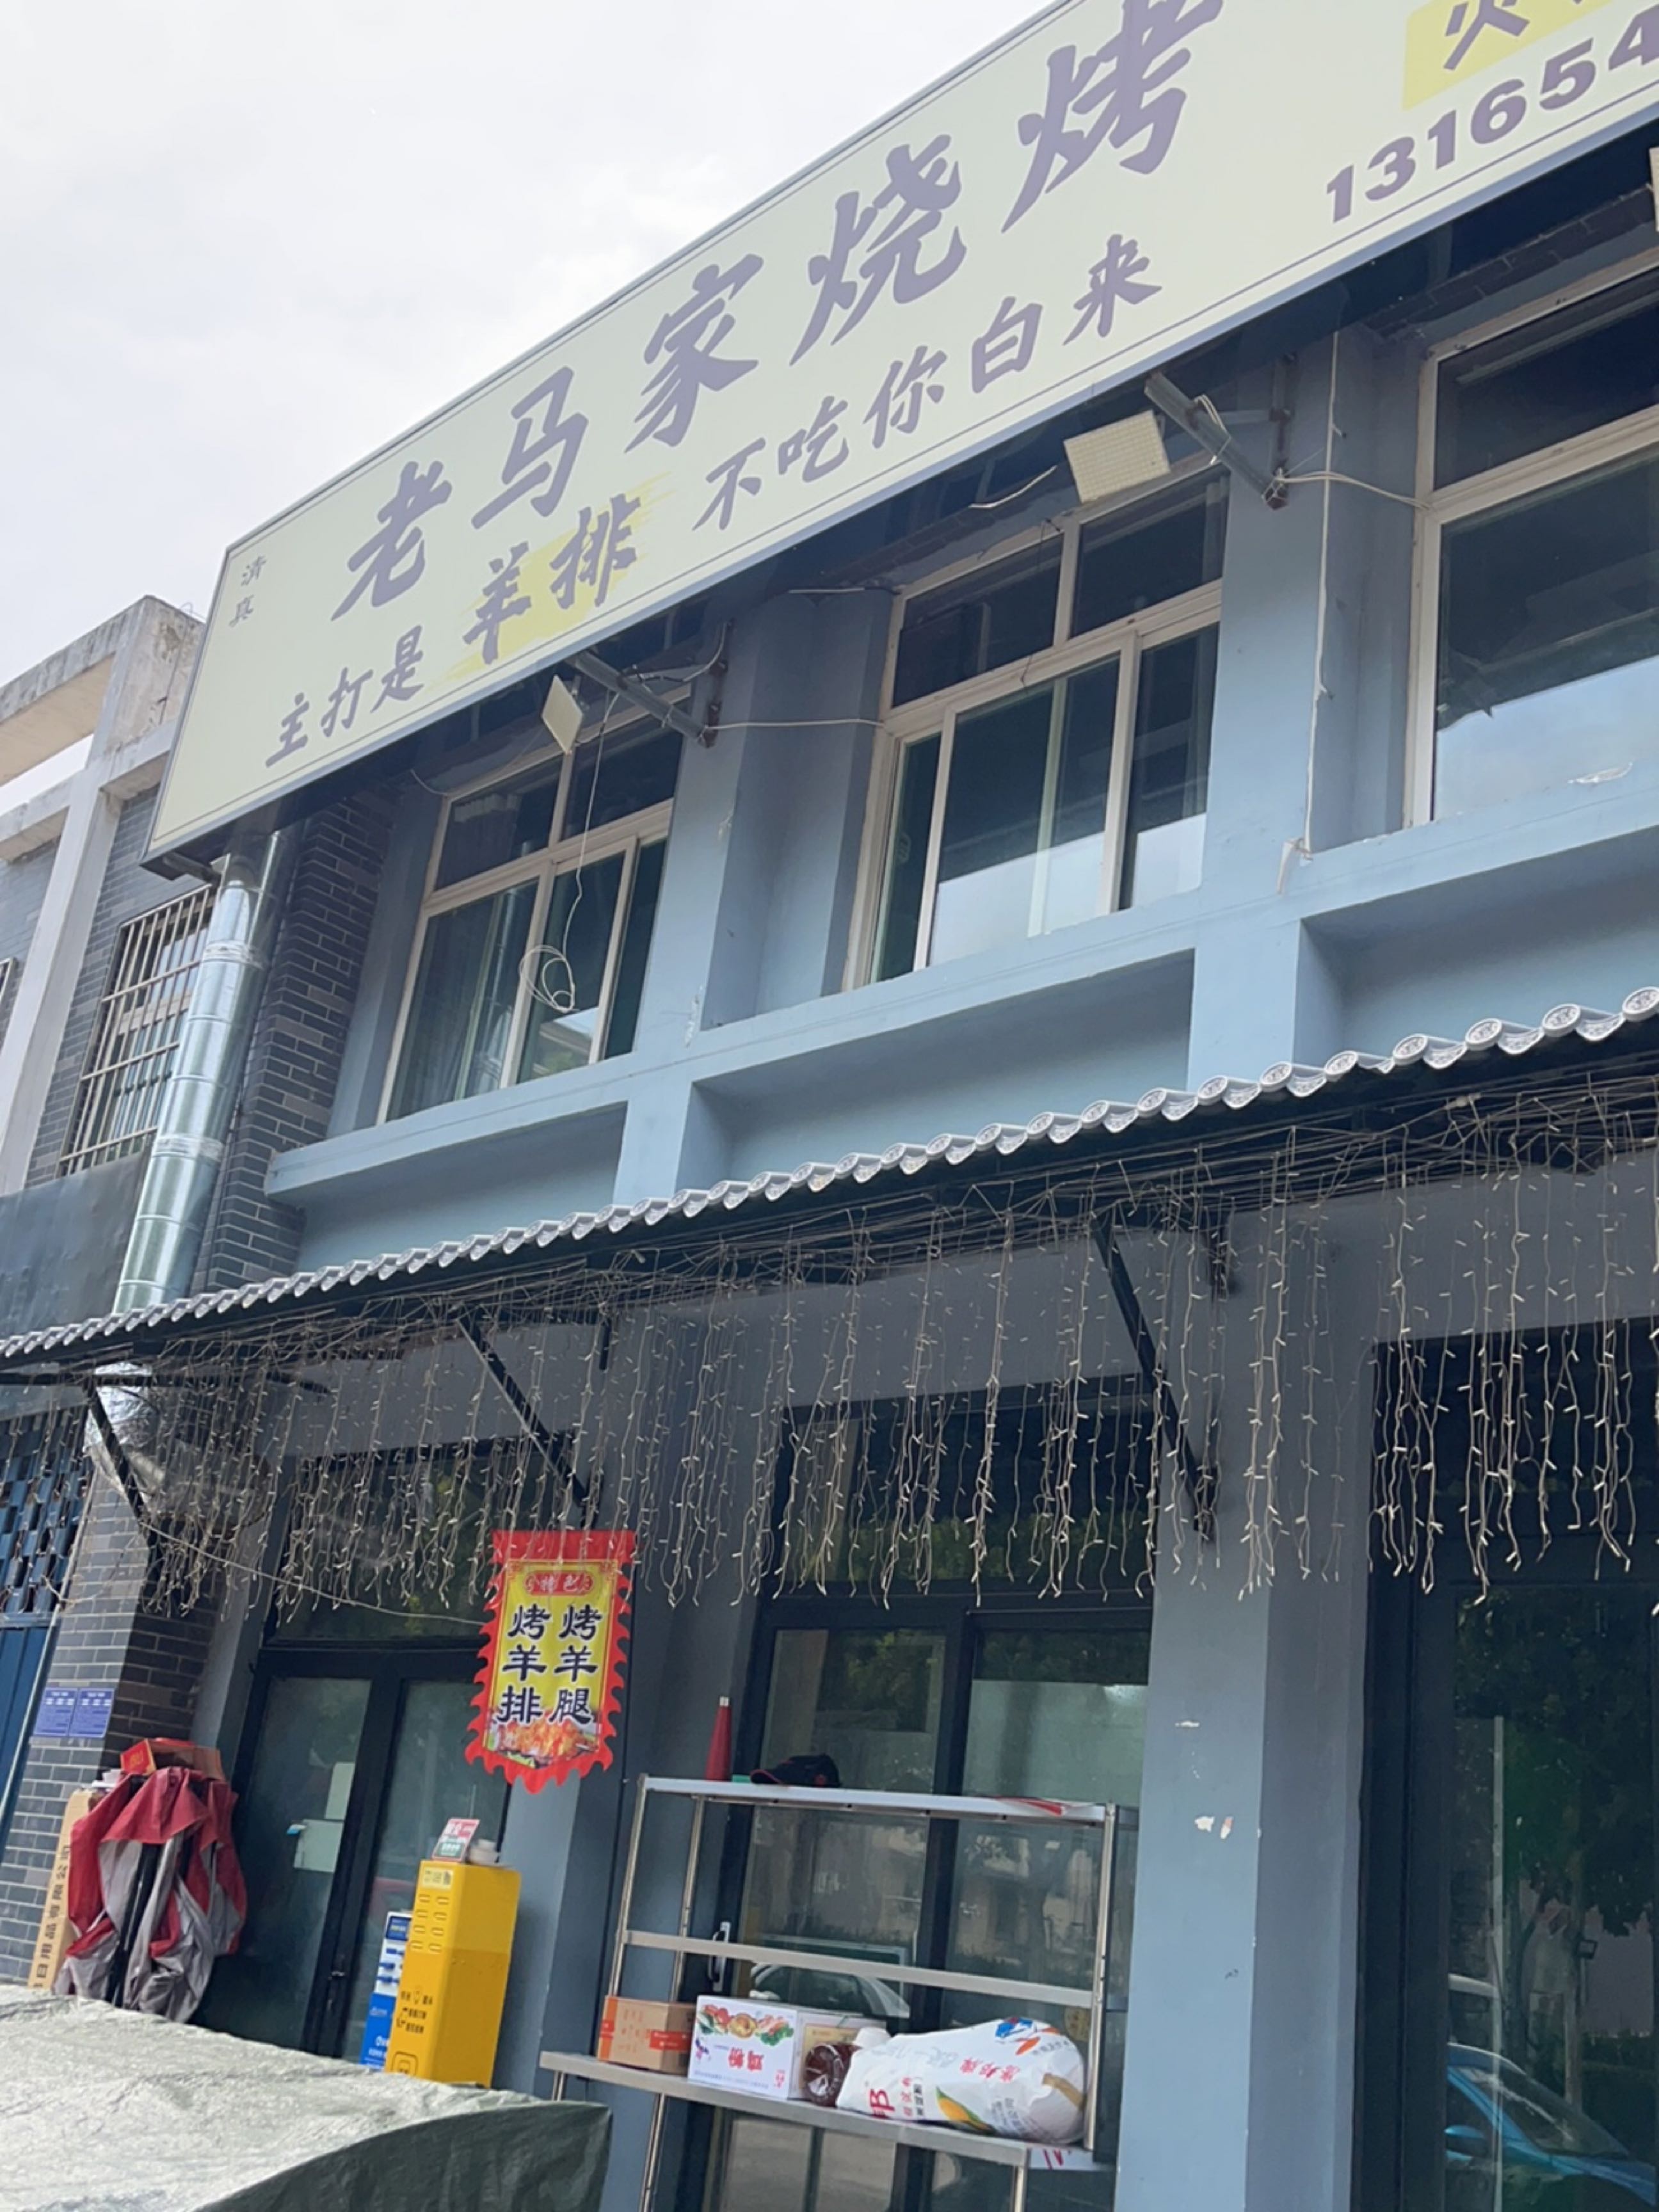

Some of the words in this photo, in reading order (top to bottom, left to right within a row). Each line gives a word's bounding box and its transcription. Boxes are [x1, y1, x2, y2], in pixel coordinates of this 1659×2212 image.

[1326, 4, 1659, 223] 131654
[1443, 0, 1583, 71] 火
[330, 0, 1224, 621] 老马家烧烤
[692, 234, 1163, 531] 不吃你白来
[495, 1603, 550, 1724] 烤羊排
[549, 1603, 602, 1724] 烤羊腿
